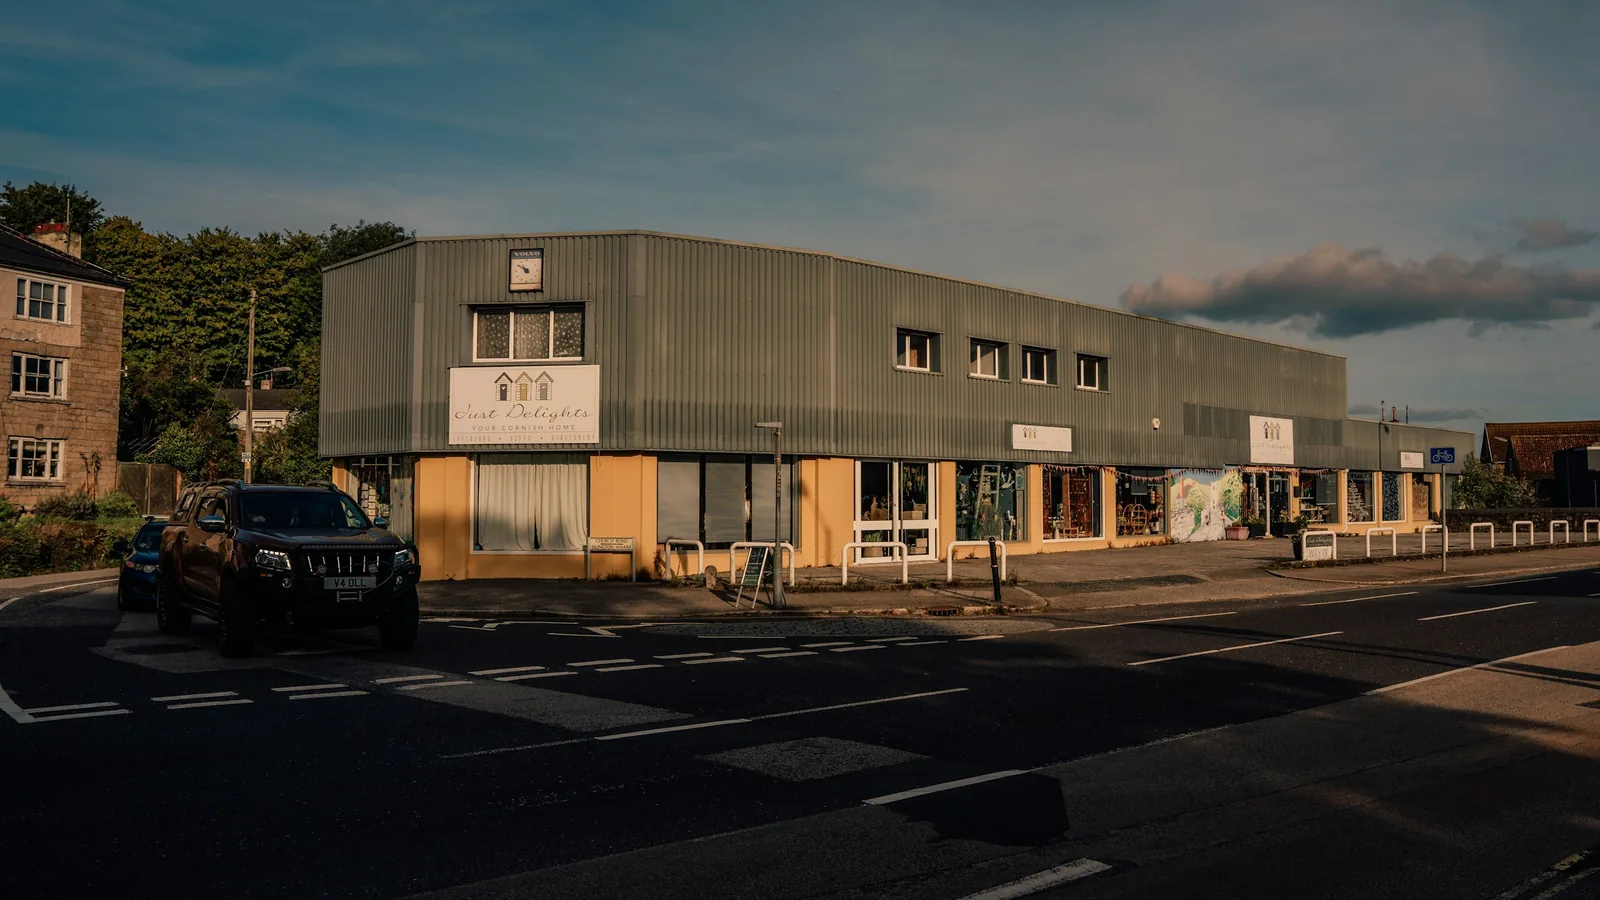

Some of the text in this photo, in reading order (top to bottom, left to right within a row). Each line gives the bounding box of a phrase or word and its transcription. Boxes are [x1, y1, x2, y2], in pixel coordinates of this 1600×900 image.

[454, 403, 593, 423] Just Delights
[334, 578, 366, 587] V4 OLL
